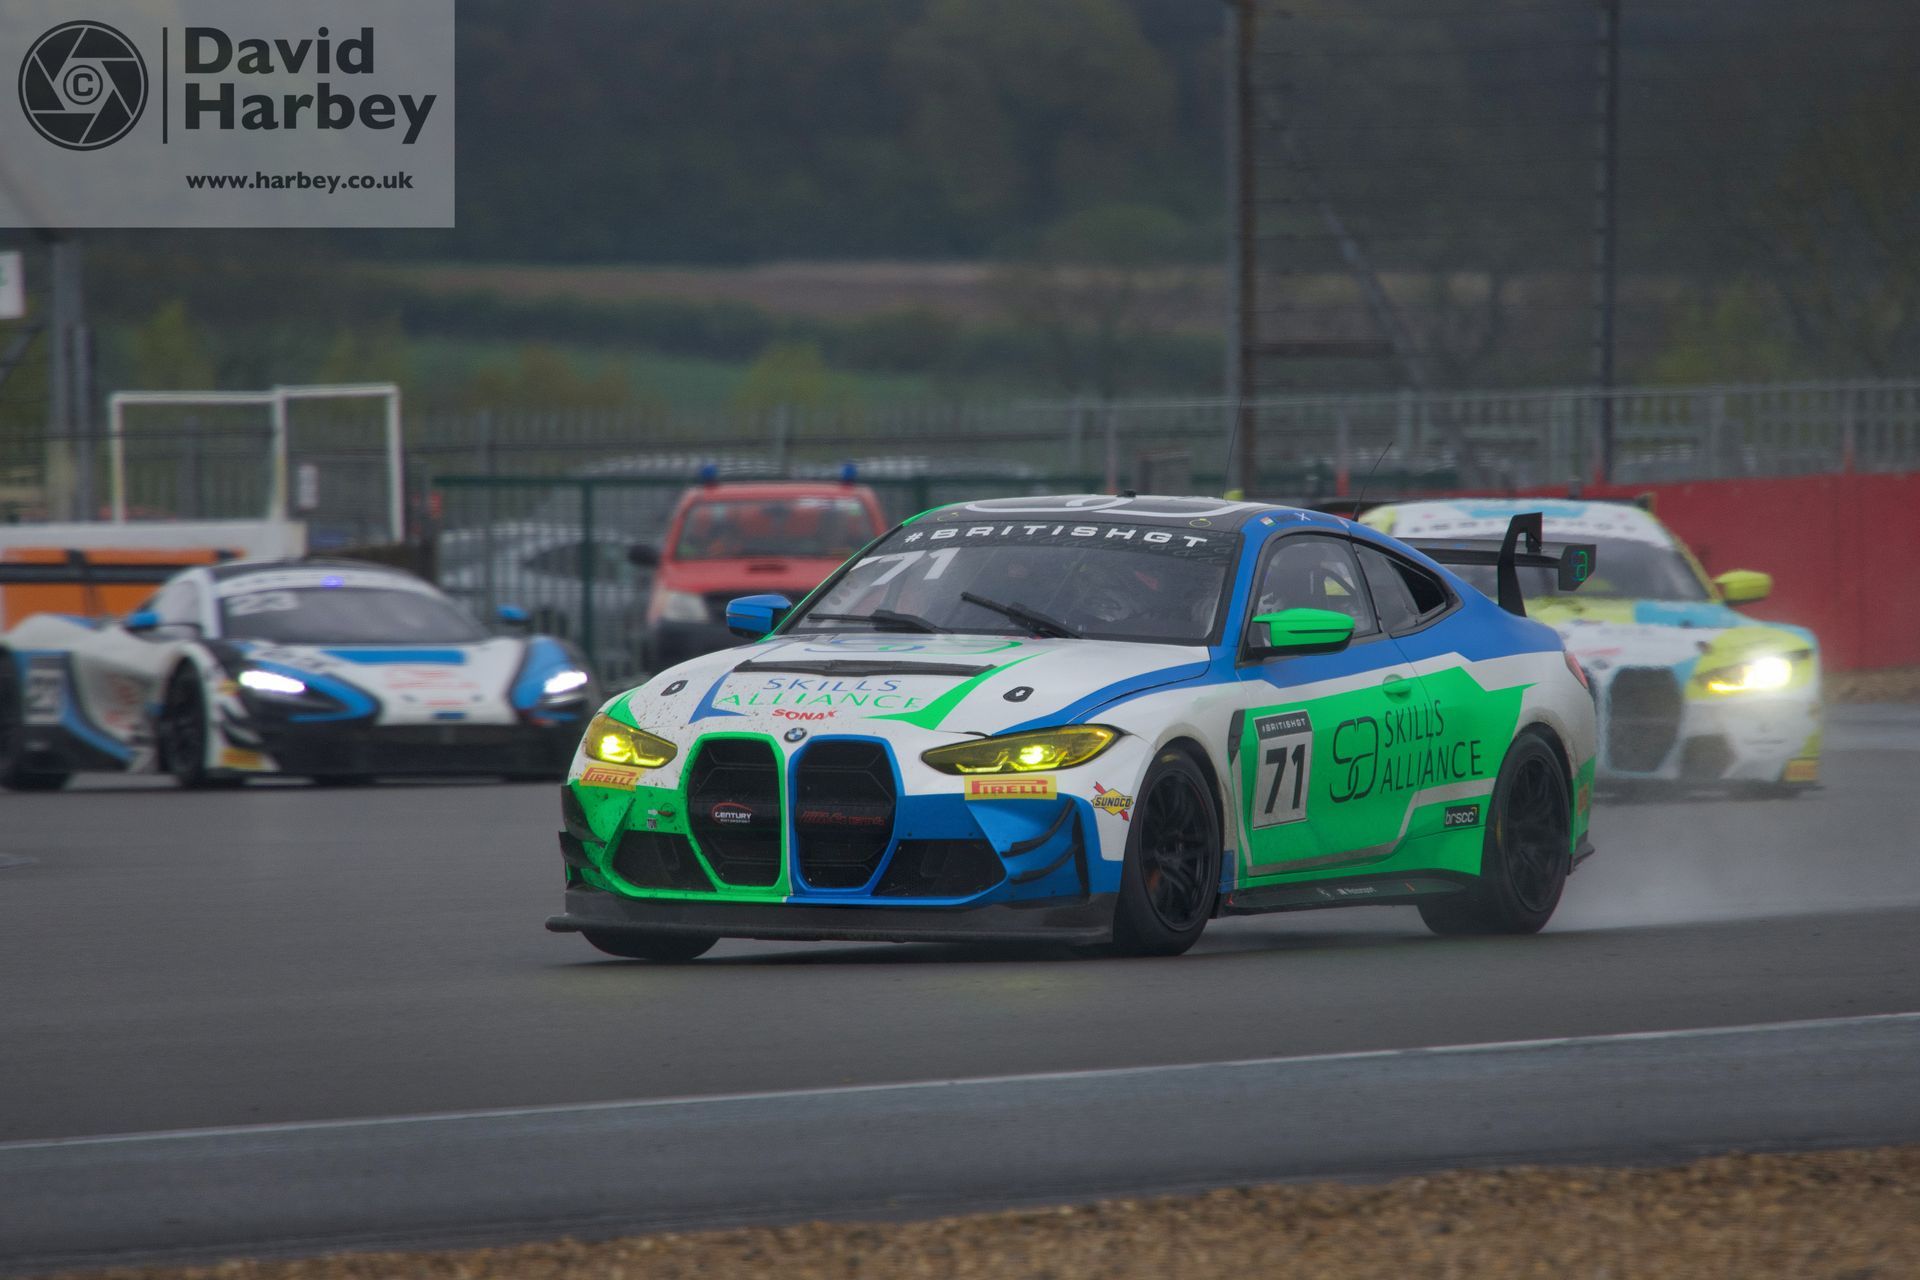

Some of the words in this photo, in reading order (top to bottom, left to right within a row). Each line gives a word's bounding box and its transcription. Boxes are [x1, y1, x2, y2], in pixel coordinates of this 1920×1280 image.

[904, 524, 1207, 548] #BRITISHGT
[849, 547, 961, 587] 71
[762, 678, 902, 692] SKILLS
[715, 692, 924, 709] ALLIANCE
[772, 708, 838, 721] SONAX
[1384, 700, 1445, 749] SKILLS
[581, 766, 638, 785] PIRELLI
[1379, 740, 1485, 795] ALLIANCE
[971, 779, 1049, 795] PIRELLI
[1264, 743, 1306, 815] 71
[1094, 796, 1132, 808] SUNOCO
[714, 811, 752, 819] CENTURY
[1445, 810, 1475, 825] brscc
